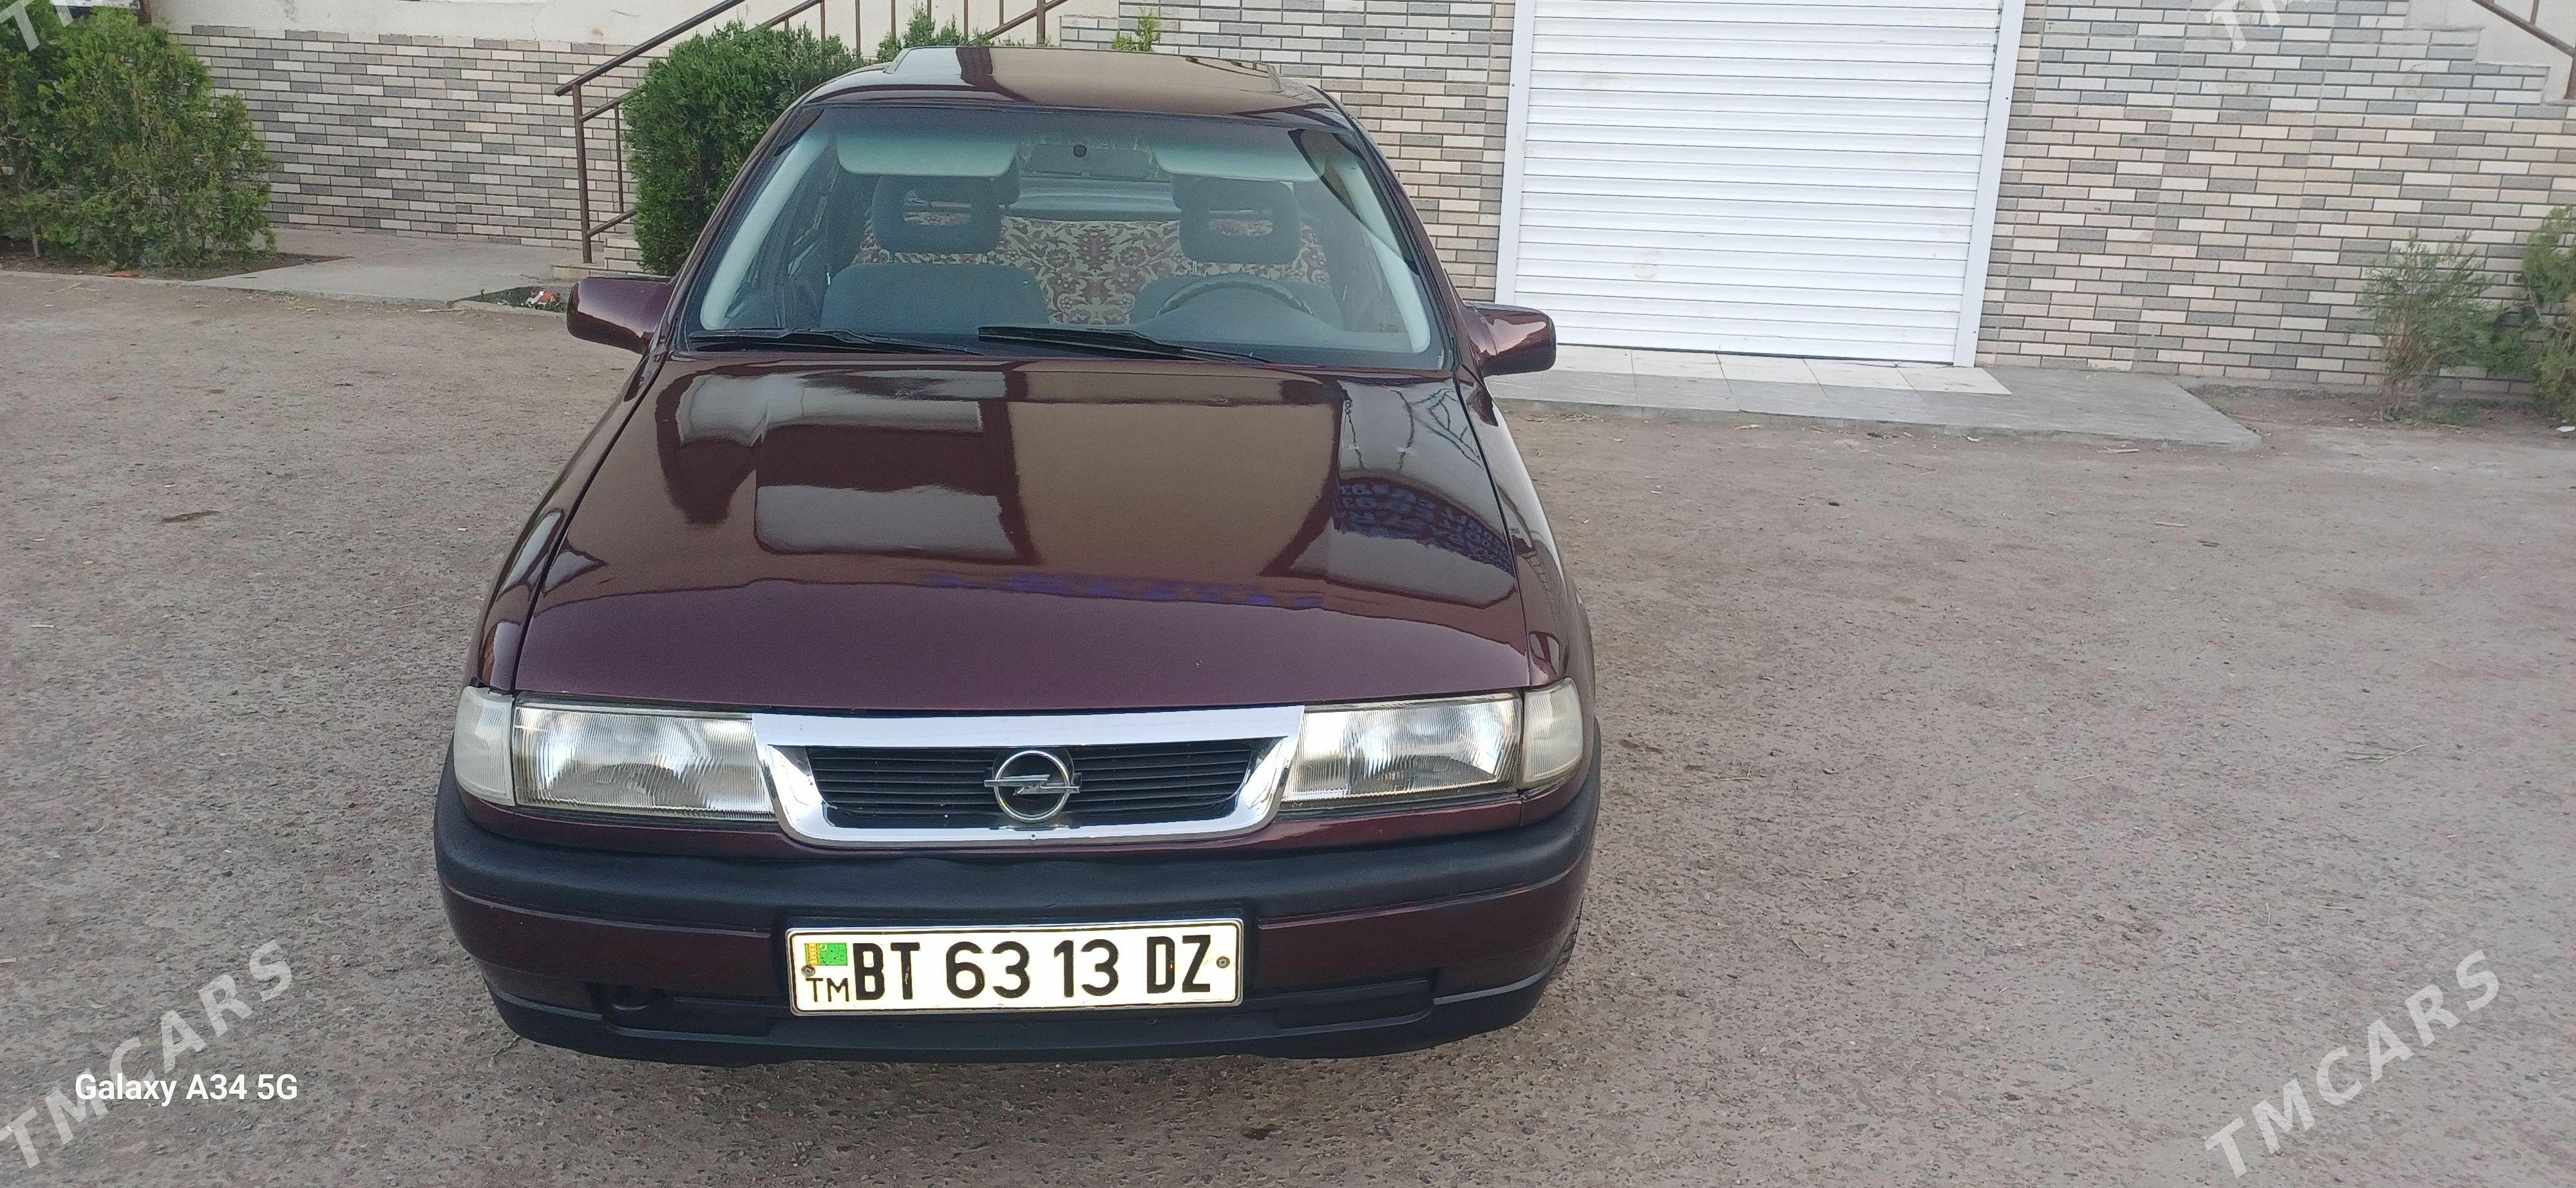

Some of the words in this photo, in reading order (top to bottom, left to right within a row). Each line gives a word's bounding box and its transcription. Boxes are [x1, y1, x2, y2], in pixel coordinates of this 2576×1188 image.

[806, 977, 849, 1002] TM
[853, 942, 920, 1000] BT
[945, 941, 1030, 999] 63
[1053, 938, 1119, 998] 13
[1146, 934, 1211, 995] DZ
